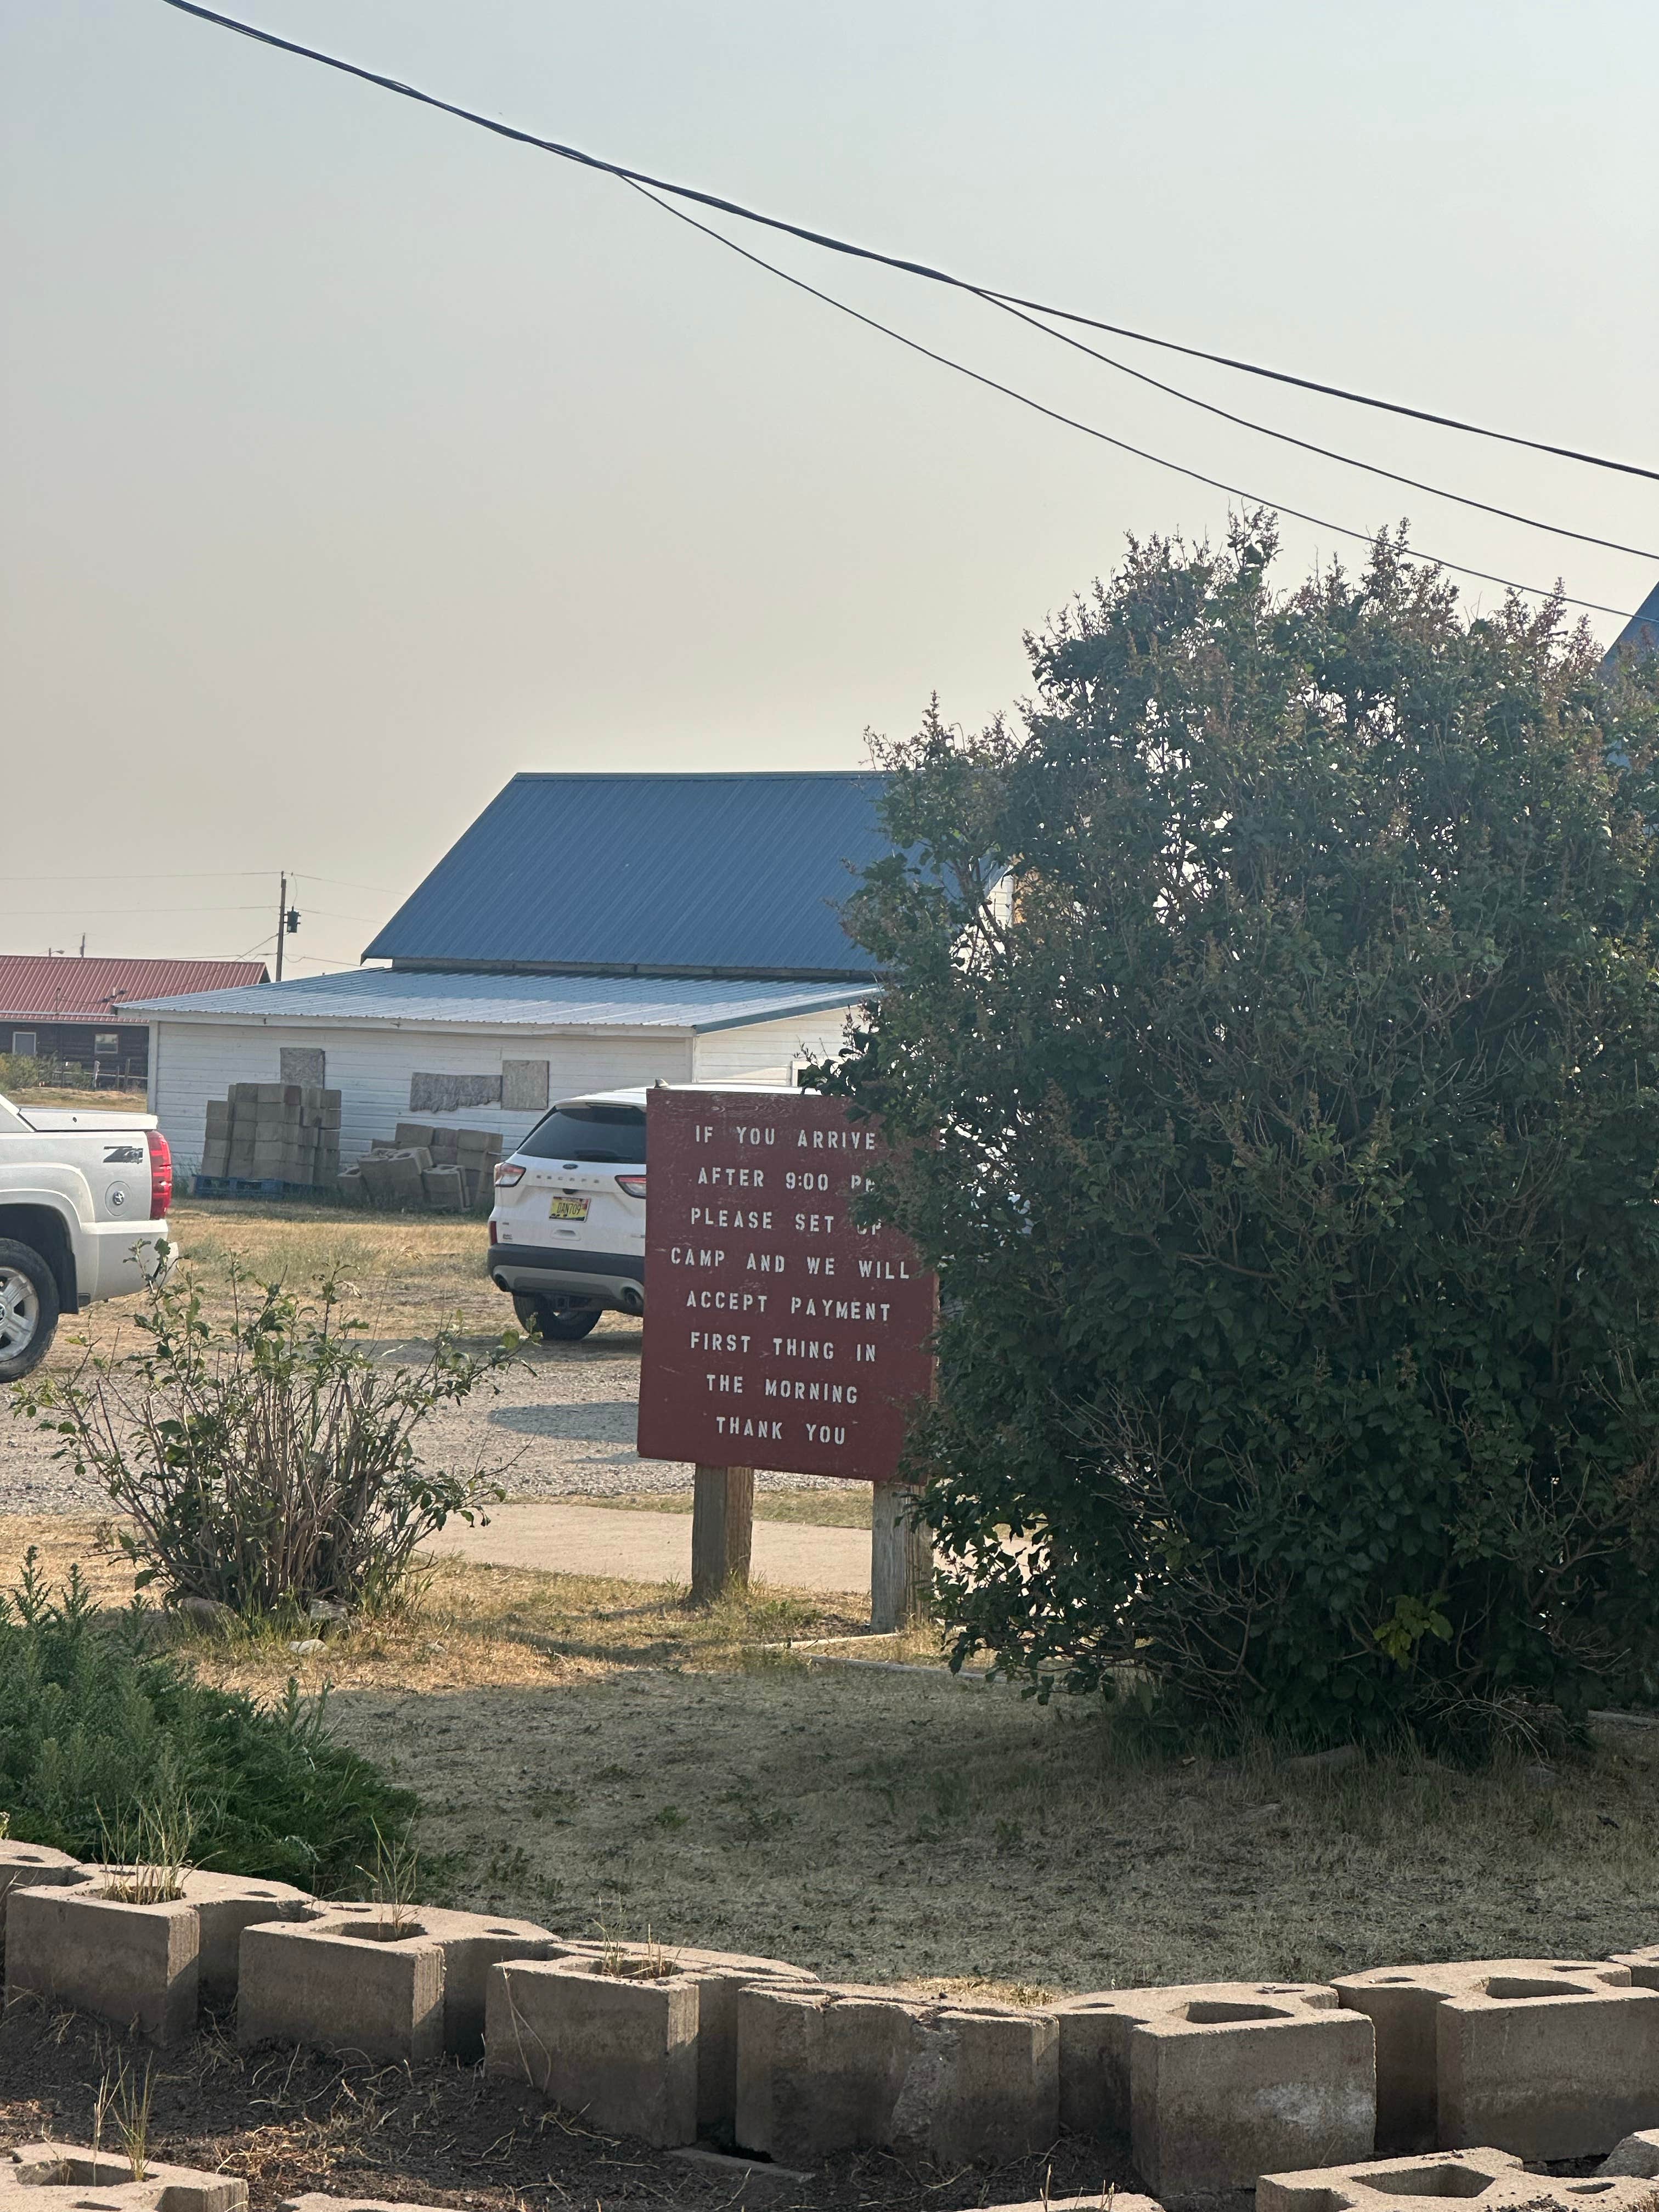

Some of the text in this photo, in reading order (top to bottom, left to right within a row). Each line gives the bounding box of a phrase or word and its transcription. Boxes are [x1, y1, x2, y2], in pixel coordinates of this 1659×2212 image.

[696, 1125, 875, 1150] IF YOU ARRIVE
[698, 1167, 764, 1187] AFTER
[786, 1172, 828, 1191] 9:00
[691, 1207, 772, 1229] PLEASE
[795, 1213, 834, 1233] SET
[671, 1247, 910, 1279] CAMP AND WE WILL
[686, 1290, 890, 1321] ACCEPT PAYMENT
[691, 1331, 875, 1362] FIRST THING IN
[706, 1374, 857, 1404] THE MORNING
[716, 1417, 845, 1444] THANK YOU
